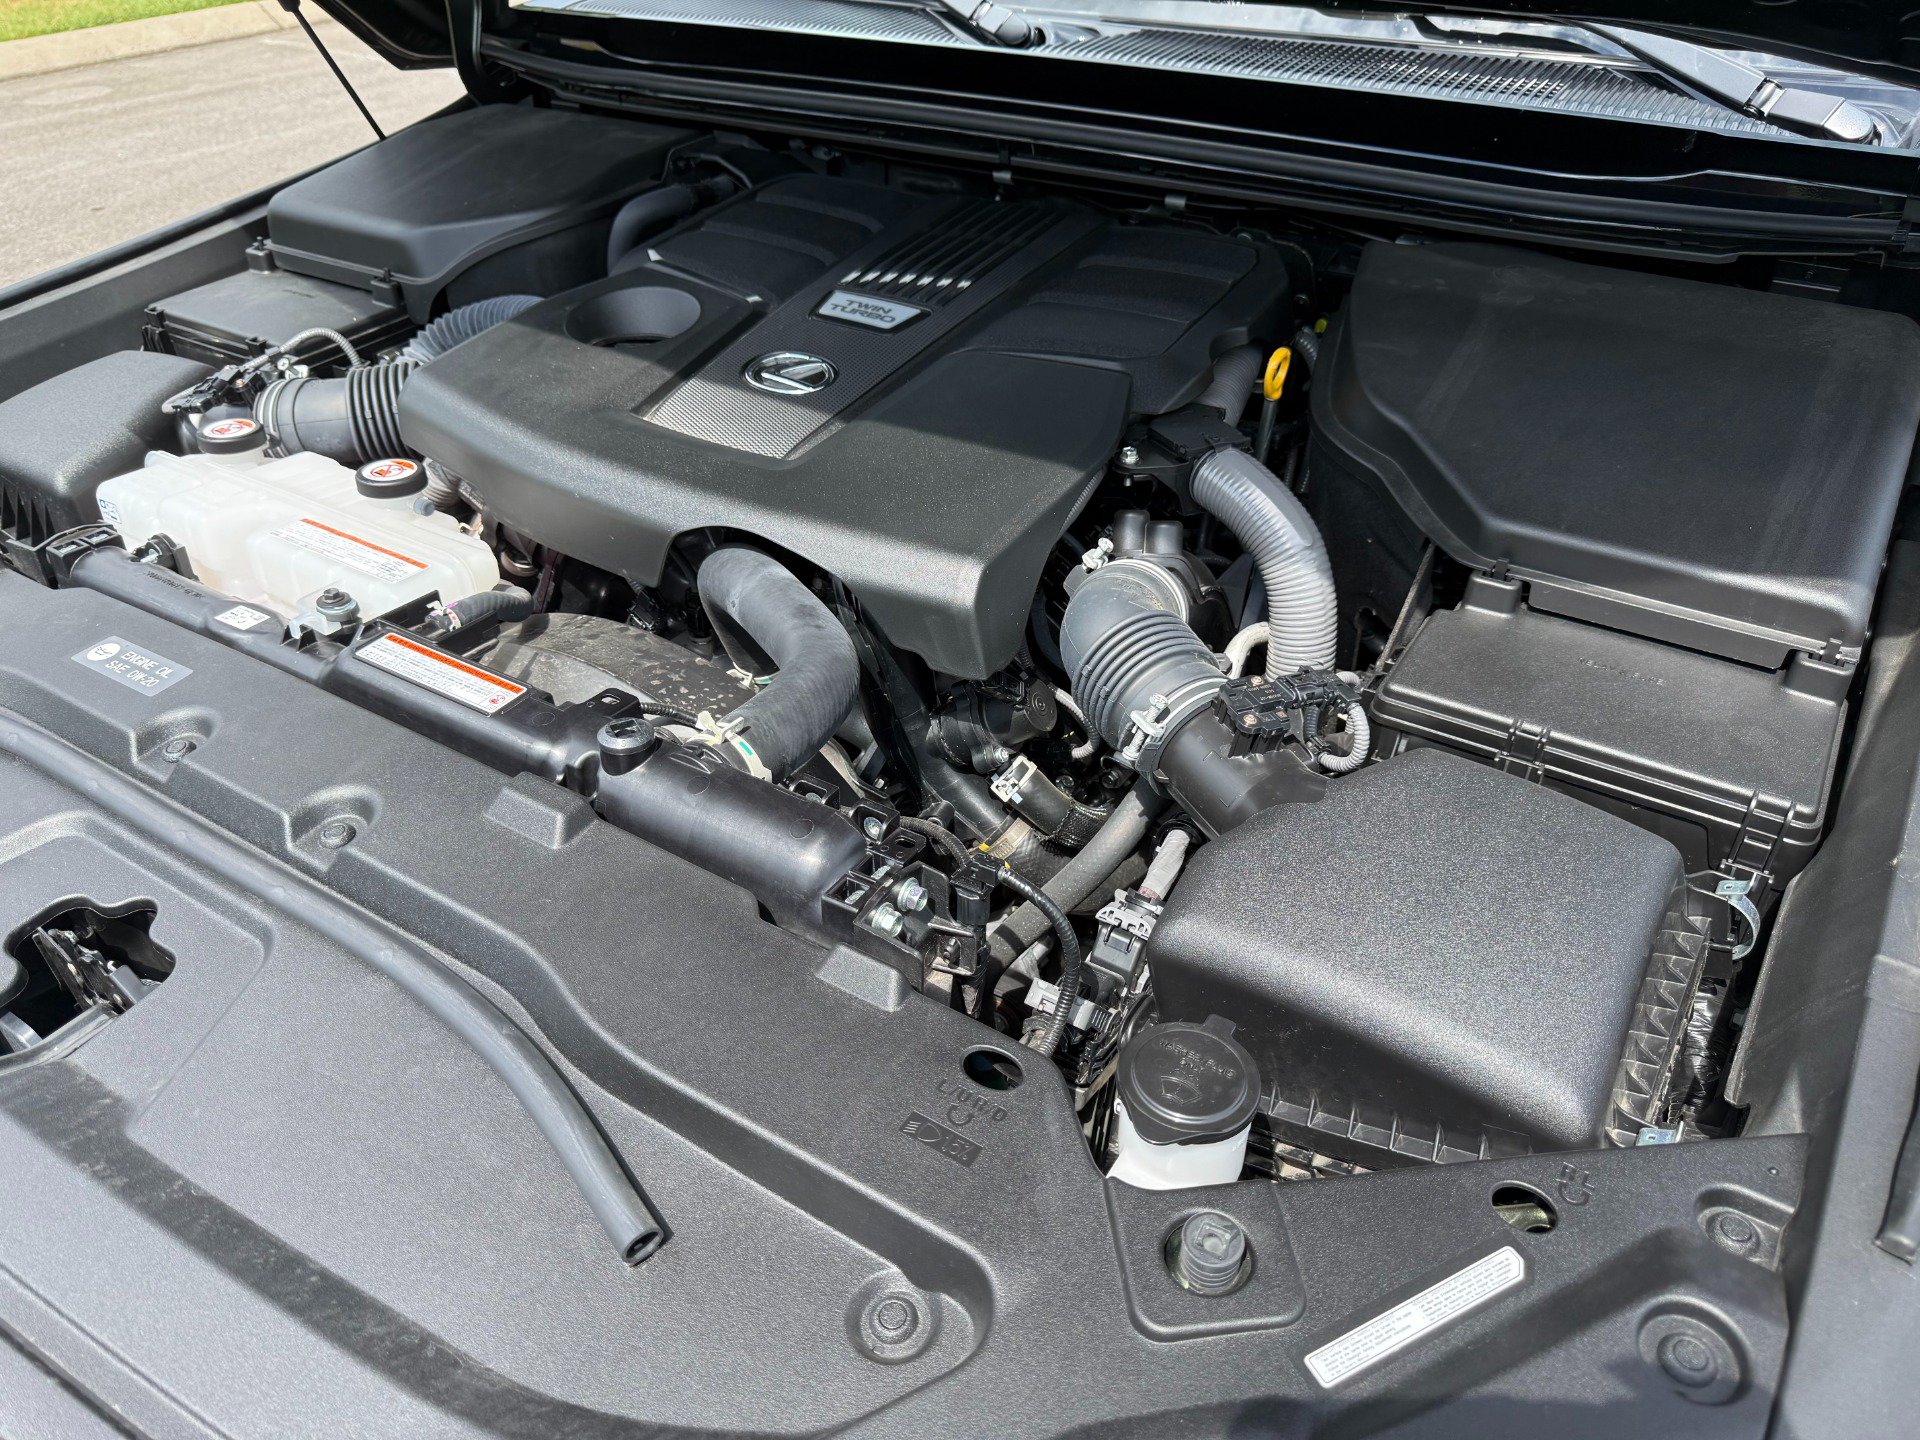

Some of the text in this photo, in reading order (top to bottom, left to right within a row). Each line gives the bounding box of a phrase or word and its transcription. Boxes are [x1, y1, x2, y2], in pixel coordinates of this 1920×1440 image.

[830, 303, 896, 323] TURBO
[846, 299, 892, 315] TWIN
[105, 659, 160, 687] SAE 0W-20
[121, 650, 174, 679] ENGINE OIL
